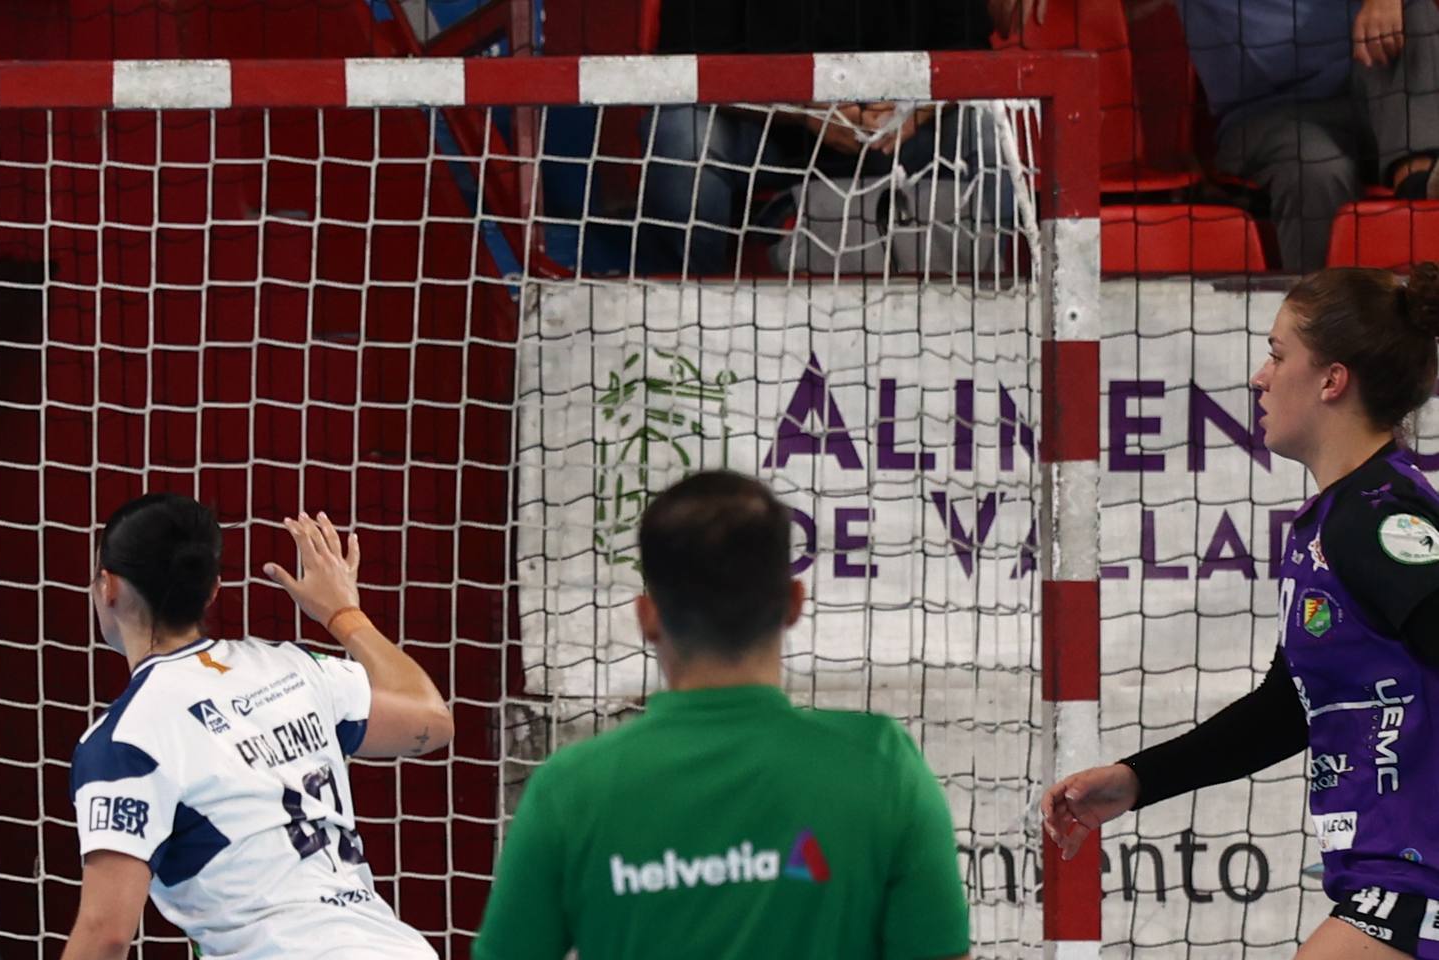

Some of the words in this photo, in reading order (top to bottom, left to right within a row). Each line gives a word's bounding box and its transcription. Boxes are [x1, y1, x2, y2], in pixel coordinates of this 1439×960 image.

[235, 711, 328, 769] POLONIO
[611, 840, 780, 896] helvetia
[1351, 886, 1399, 919] 41
